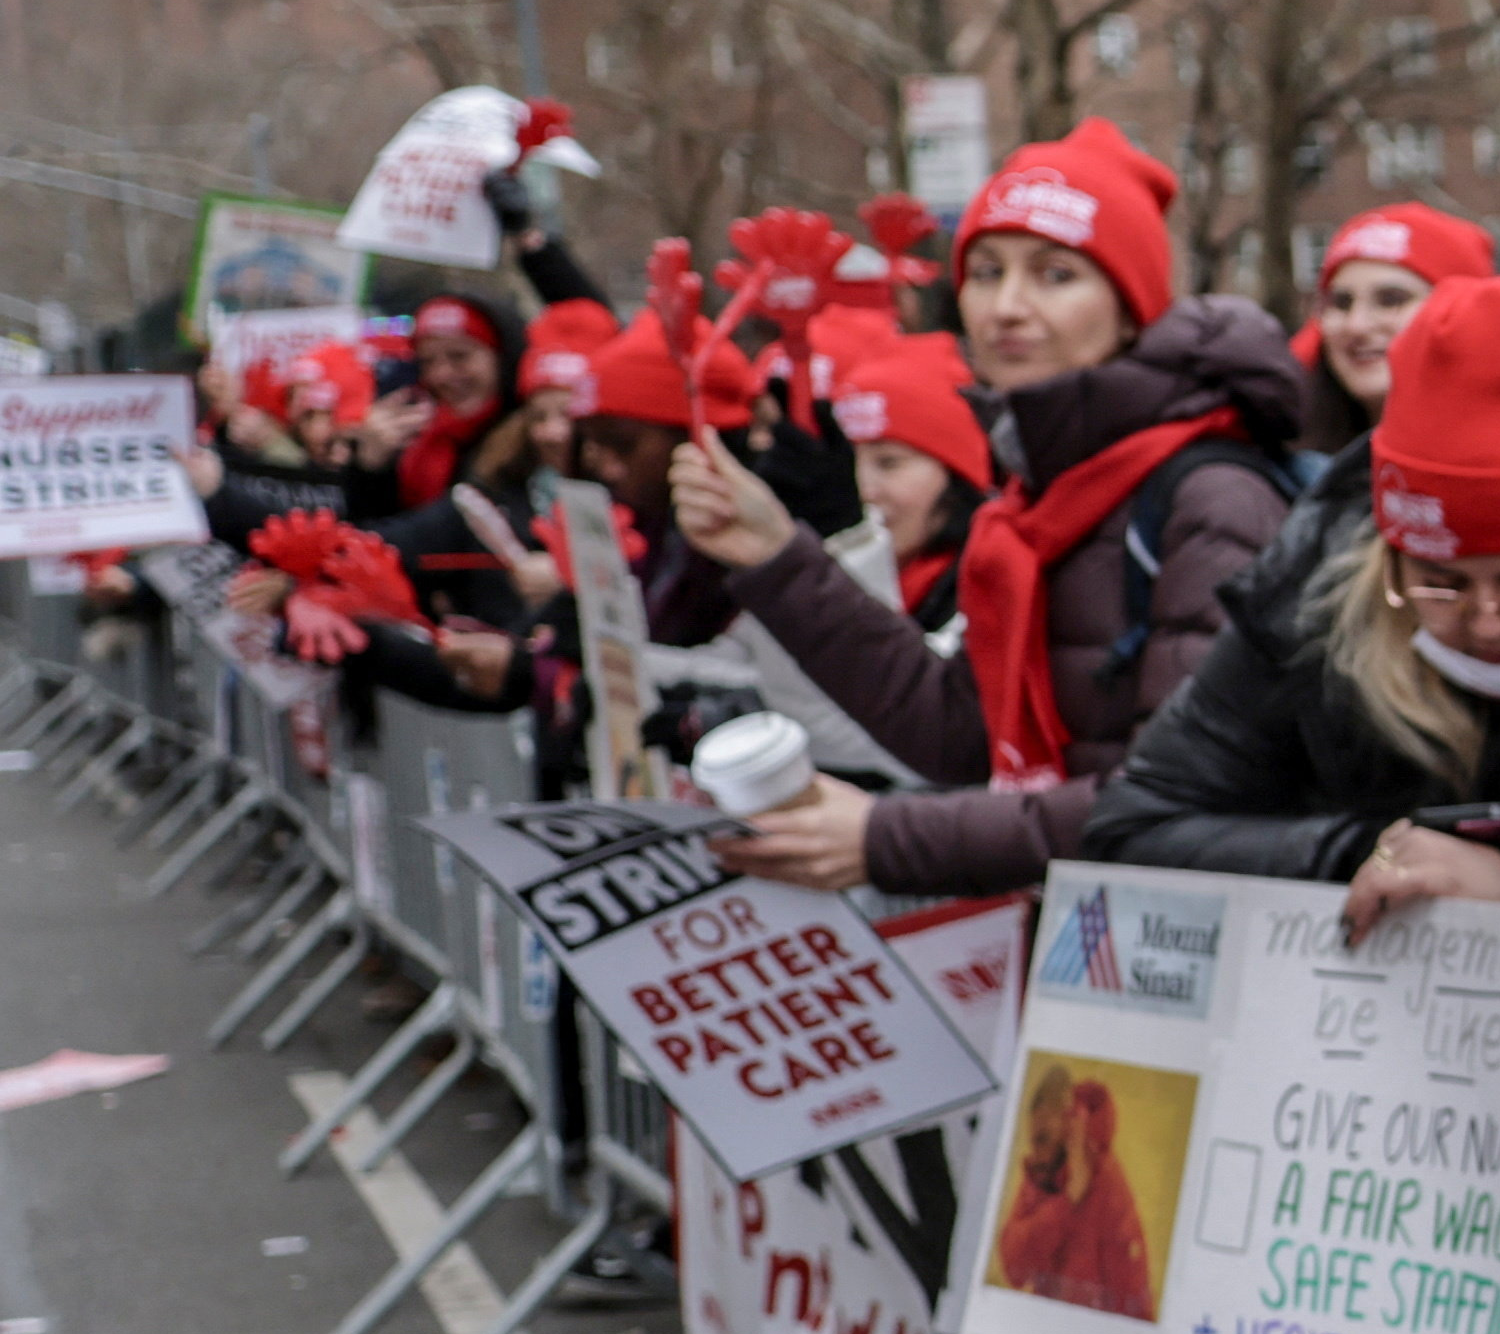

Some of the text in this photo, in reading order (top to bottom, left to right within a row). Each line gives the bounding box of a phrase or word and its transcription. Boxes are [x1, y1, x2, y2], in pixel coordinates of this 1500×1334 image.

[4, 474, 170, 505] STRIKE
[530, 830, 735, 945] STRIK
[653, 896, 765, 962] FOR
[630, 925, 850, 1026] BETTER
[1137, 912, 1221, 957] Mount
[655, 963, 895, 1077] PATIENT
[1128, 959, 1197, 1002] Sinai
[1313, 984, 1381, 1047] be
[737, 1020, 897, 1100] CARE
[1273, 1083, 1373, 1161] GIVE
[1383, 1103, 1457, 1170] OUR
[1273, 1161, 1305, 1227] A
[1321, 1168, 1422, 1248] FAIR
[1259, 1237, 1374, 1323] SAFE
